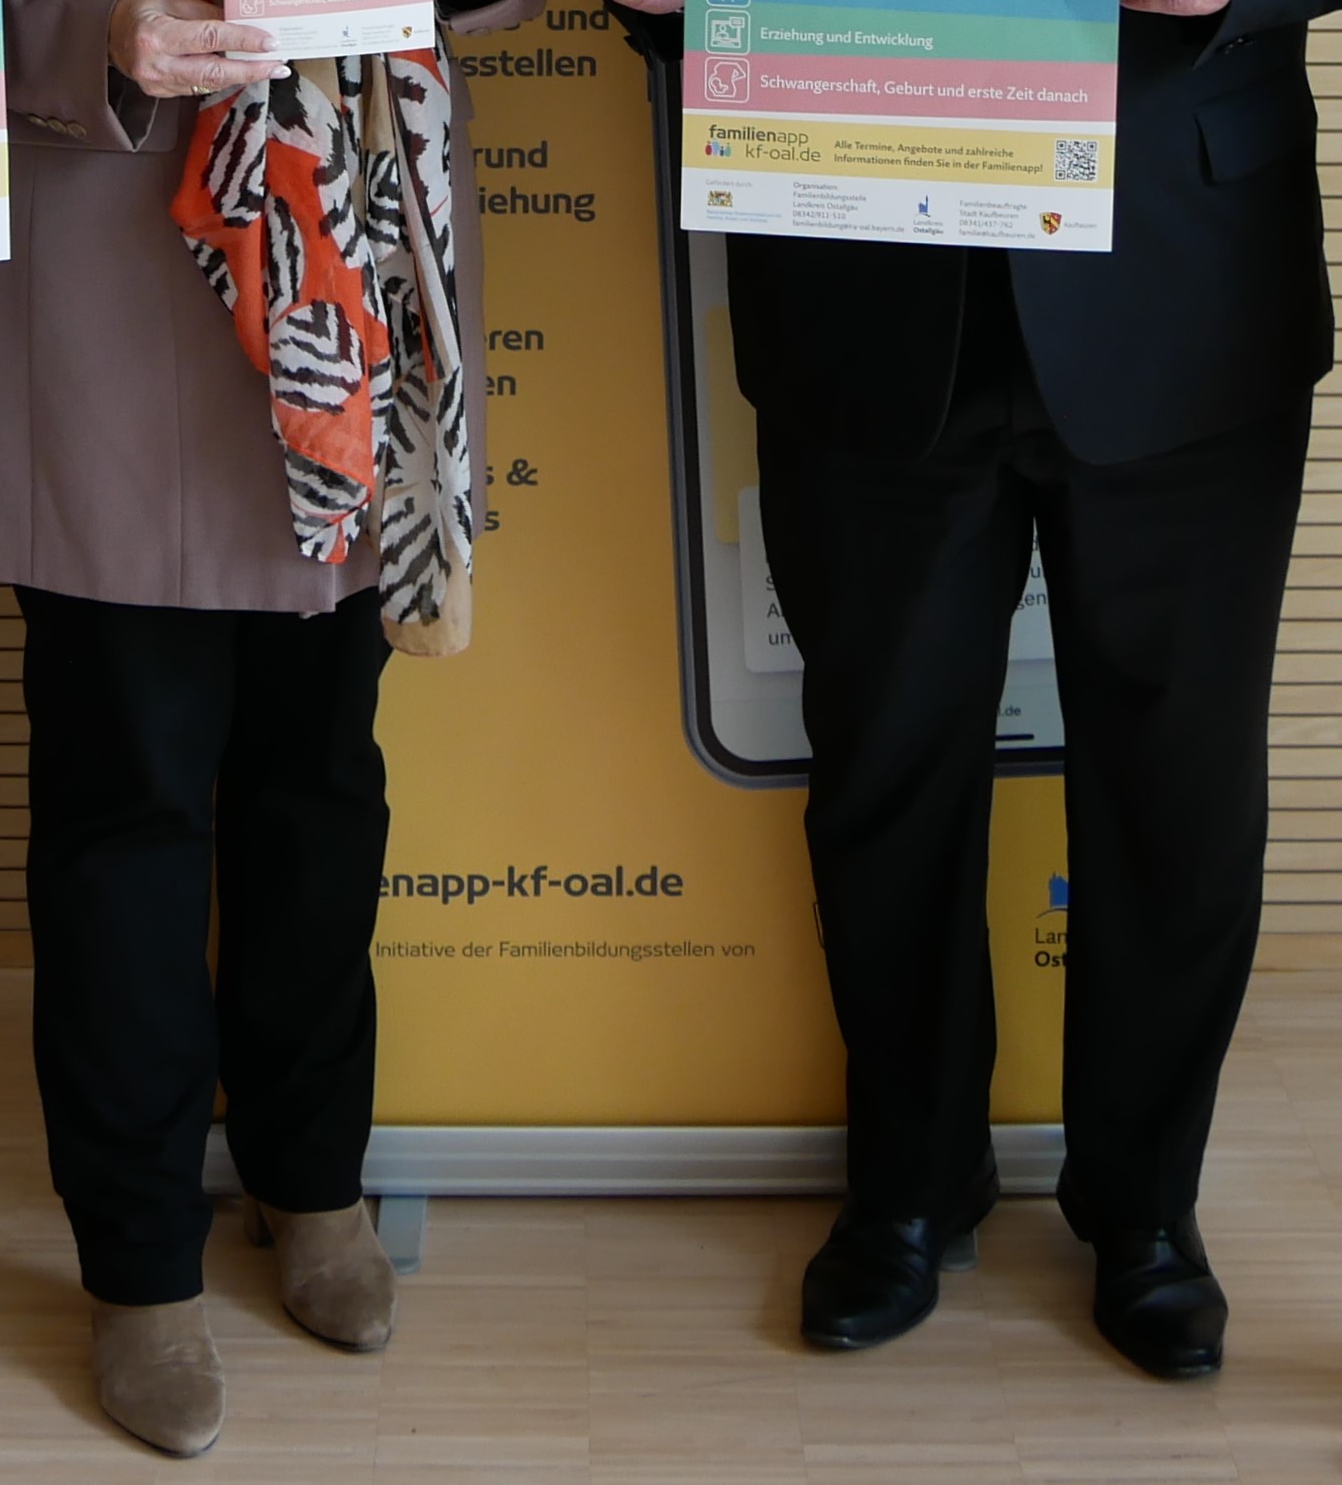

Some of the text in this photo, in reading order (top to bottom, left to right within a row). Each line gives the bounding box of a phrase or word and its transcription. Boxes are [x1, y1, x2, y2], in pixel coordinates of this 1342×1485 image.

[546, 10, 609, 31] und
[760, 26, 934, 51] Erziehung und Entwicklung
[460, 48, 597, 77] sstellen
[760, 74, 1088, 104] Schwangerschaft, Geburt und erste Zeit danach
[709, 124, 809, 147] familienapp
[473, 140, 548, 168] rund
[746, 143, 821, 163] kf-oal.de
[834, 140, 1014, 159] Alle Termine, Angebote und zahlreiche
[834, 153, 1043, 175] Informationen finden Sie der Familienapp!
[479, 186, 596, 223] iehung
[379, 865, 684, 904] enapp-kf-oal.de
[376, 941, 755, 962] Initiative der Familienbildungsstellen von
